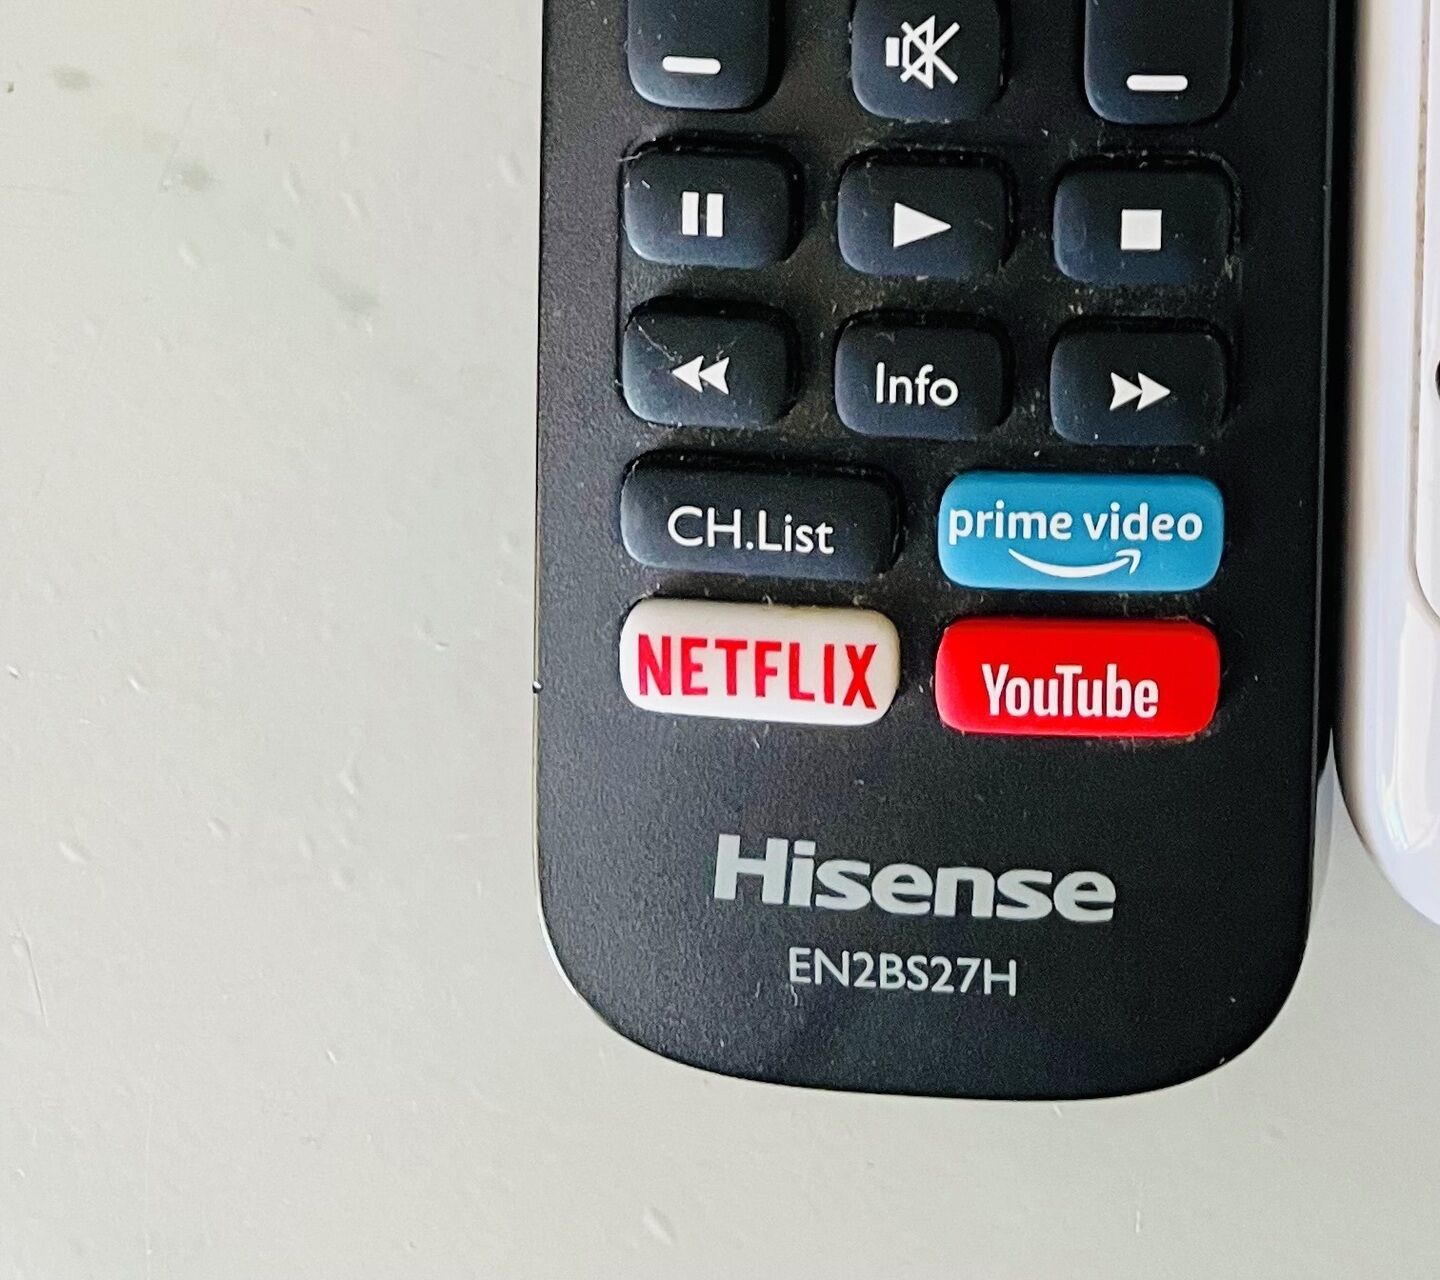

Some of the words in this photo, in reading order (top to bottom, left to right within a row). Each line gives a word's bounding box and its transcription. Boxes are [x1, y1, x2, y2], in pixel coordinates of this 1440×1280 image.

[876, 362, 958, 406] Info
[668, 506, 834, 554] CH.List
[948, 502, 1073, 546] prime
[1083, 502, 1202, 541] video
[638, 635, 878, 710] NETFLIX
[982, 664, 1158, 718] YouTube
[713, 834, 1117, 923] Hisense
[789, 948, 1017, 997] EN2BS27H
